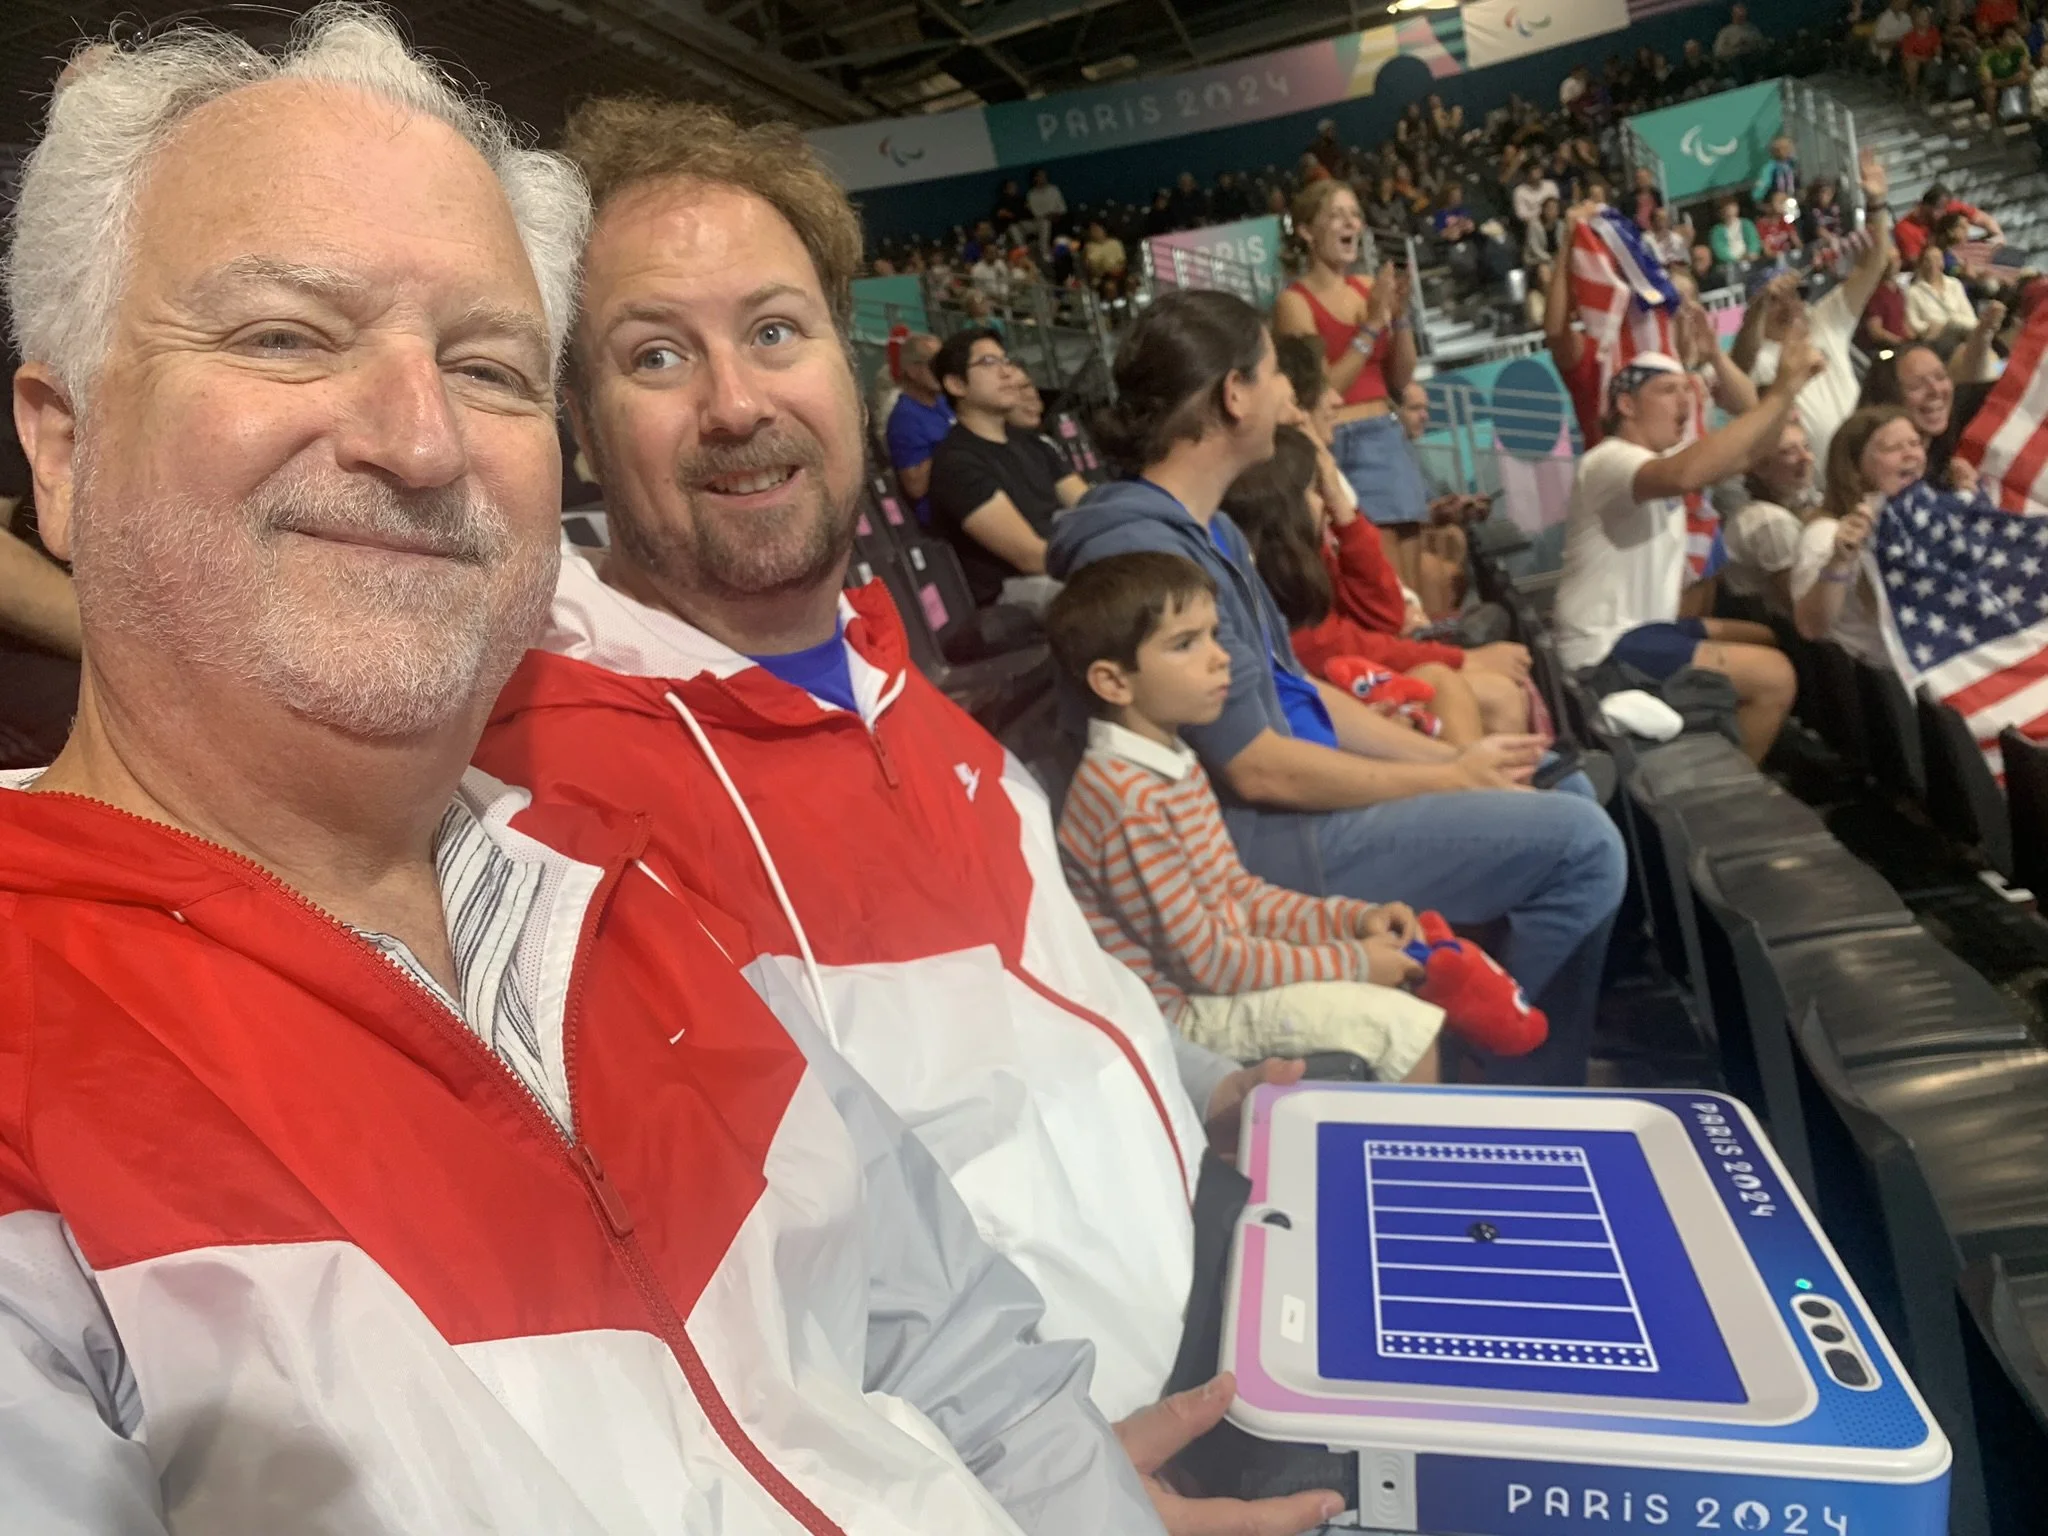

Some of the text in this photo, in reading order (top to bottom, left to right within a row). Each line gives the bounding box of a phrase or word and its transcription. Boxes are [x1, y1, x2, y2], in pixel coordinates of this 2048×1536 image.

[1175, 70, 1290, 118] 2024
[1722, 1161, 1777, 1217] 2024
[1695, 1497, 1848, 1536] 2024
